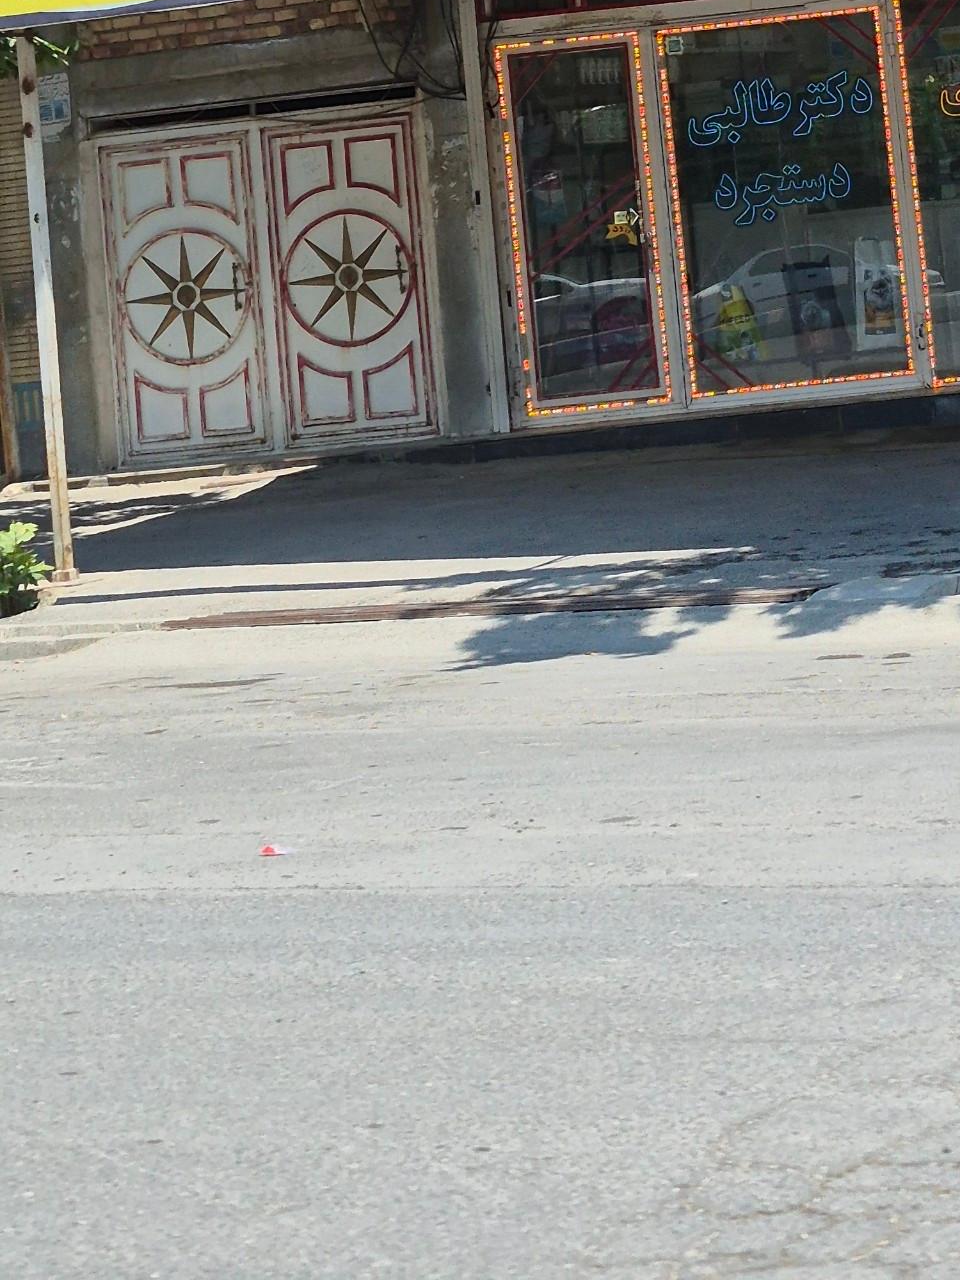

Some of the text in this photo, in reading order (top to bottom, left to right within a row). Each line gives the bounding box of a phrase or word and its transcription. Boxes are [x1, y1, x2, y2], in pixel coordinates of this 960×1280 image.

[687, 70, 873, 147] دکتر طالبی
[714, 162, 851, 226] دستجرد
